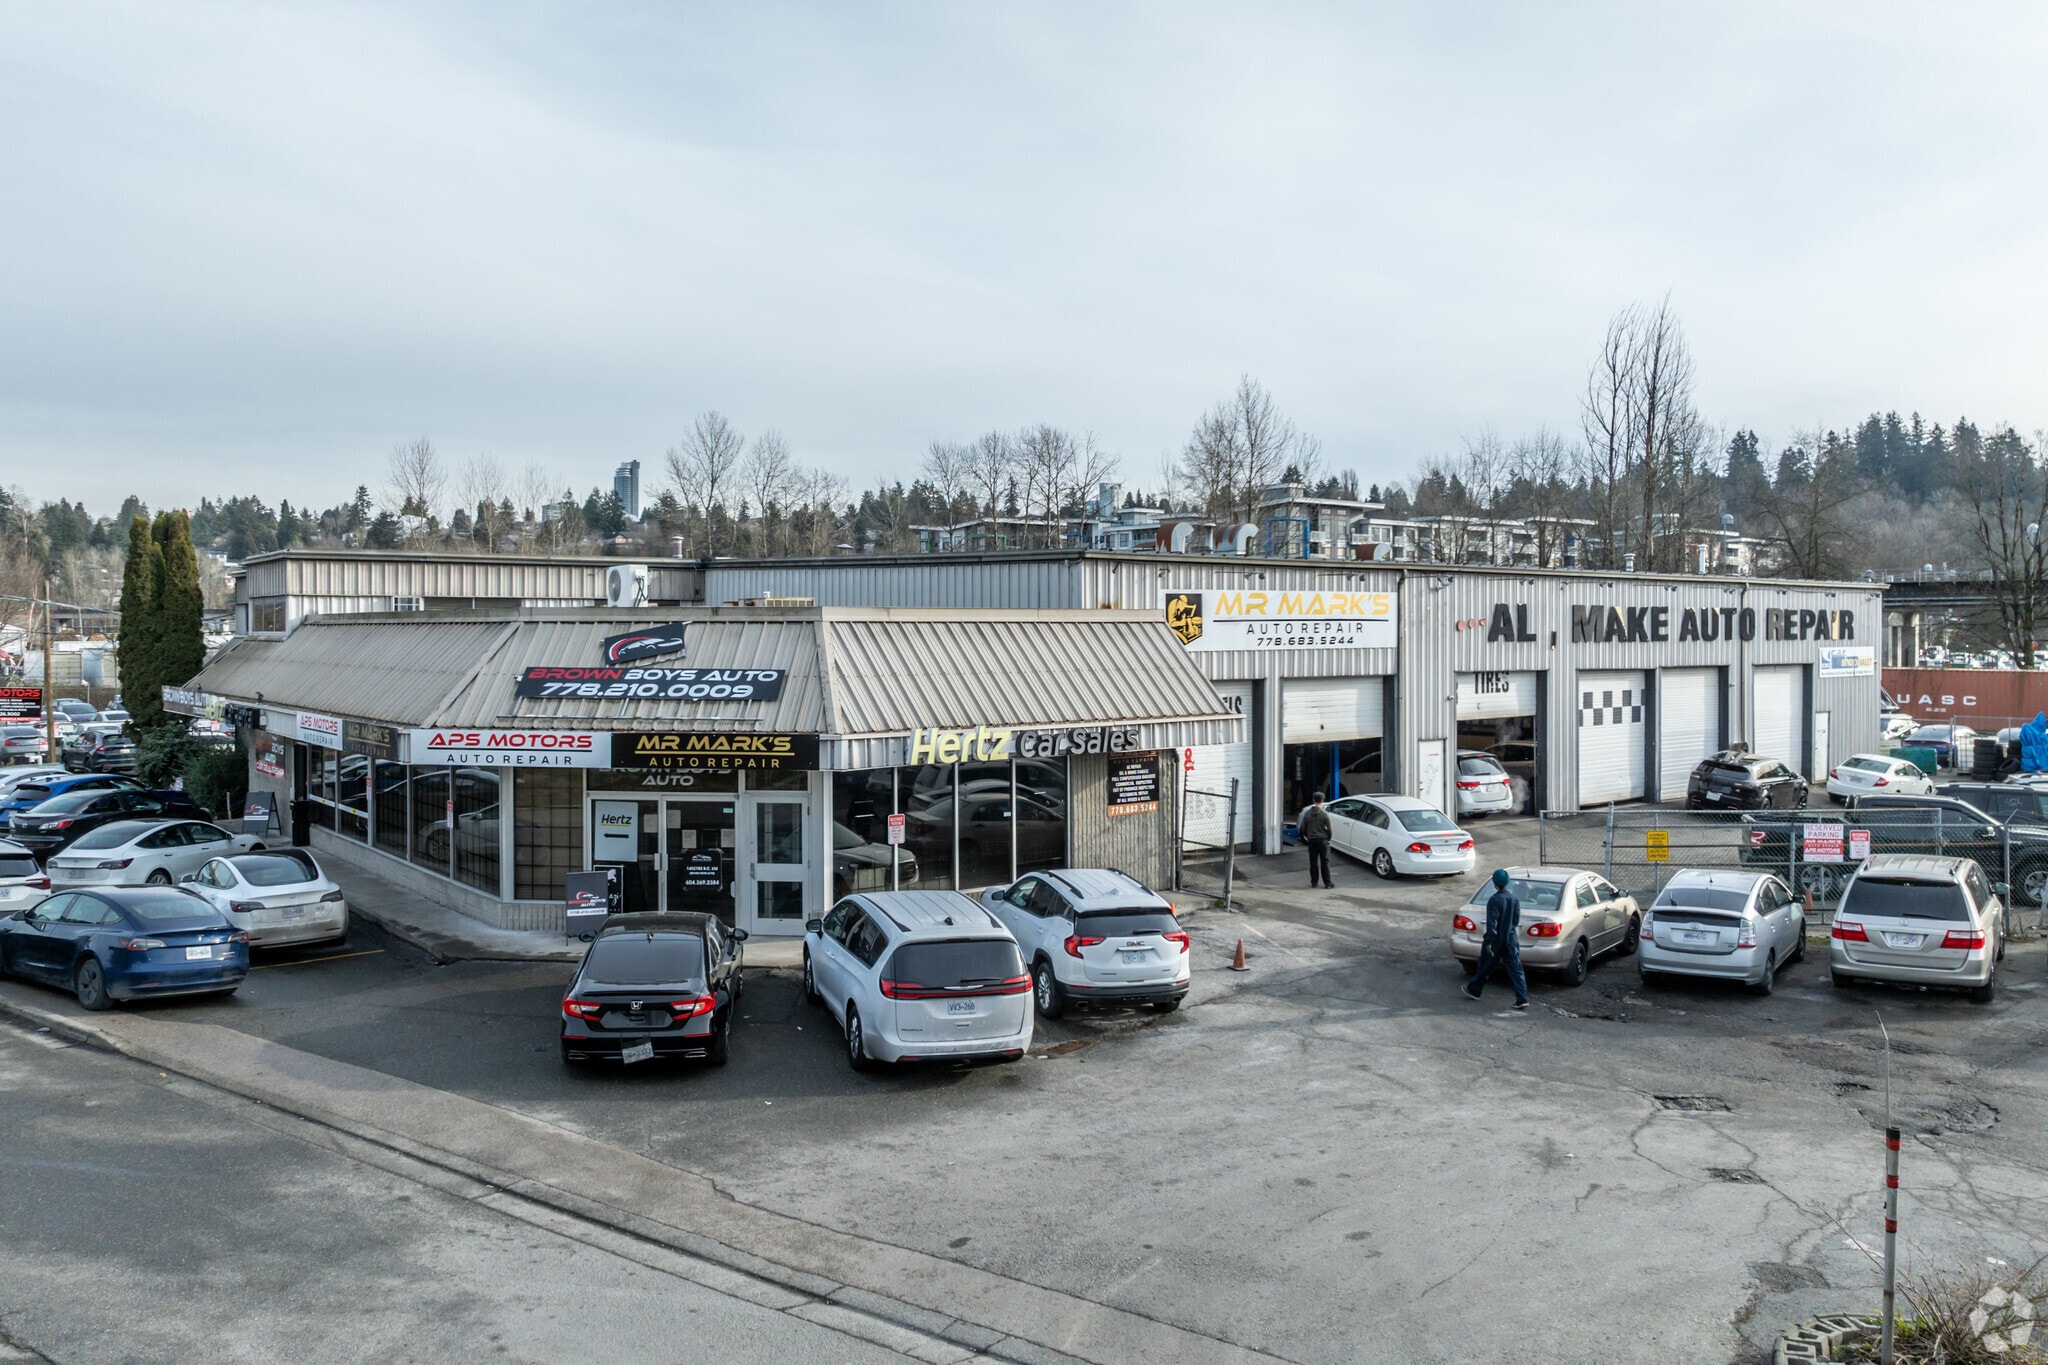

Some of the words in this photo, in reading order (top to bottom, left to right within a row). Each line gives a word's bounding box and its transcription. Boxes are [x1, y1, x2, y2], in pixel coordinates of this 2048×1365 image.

[1214, 592, 1268, 616] MR
[1276, 592, 1390, 616] MARK'S
[1246, 623, 1293, 634] AUTO
[1302, 622, 1364, 634] REPAIR
[1572, 604, 1669, 643] MAKE
[1679, 606, 1756, 642] AUTO
[1766, 608, 1854, 641] REPAIR
[1257, 636, 1354, 646] 778.683.5244
[528, 668, 624, 680] BROWN
[624, 669, 699, 681] BOYS
[700, 670, 778, 682] AUTO
[539, 683, 754, 698] 778.210.0009
[1473, 672, 1510, 694] TIRES
[1896, 694, 1976, 706] UASC
[300, 714, 313, 728] APS
[313, 716, 338, 733] MOTORS
[361, 725, 390, 741] MARK'S
[428, 733, 481, 746] APS
[486, 734, 593, 748] MOTORS
[636, 735, 680, 750] MR
[686, 736, 792, 751] MARK'S
[910, 725, 1012, 765] Hertz
[1018, 730, 1068, 758] Car
[1070, 726, 1139, 755] Sales
[447, 754, 495, 764] AUTO
[503, 755, 572, 765] REPAIR
[649, 757, 699, 767] AUTO
[708, 758, 780, 768] REPAIR
[642, 775, 694, 786] AUTO
[601, 814, 632, 824] Hertz
